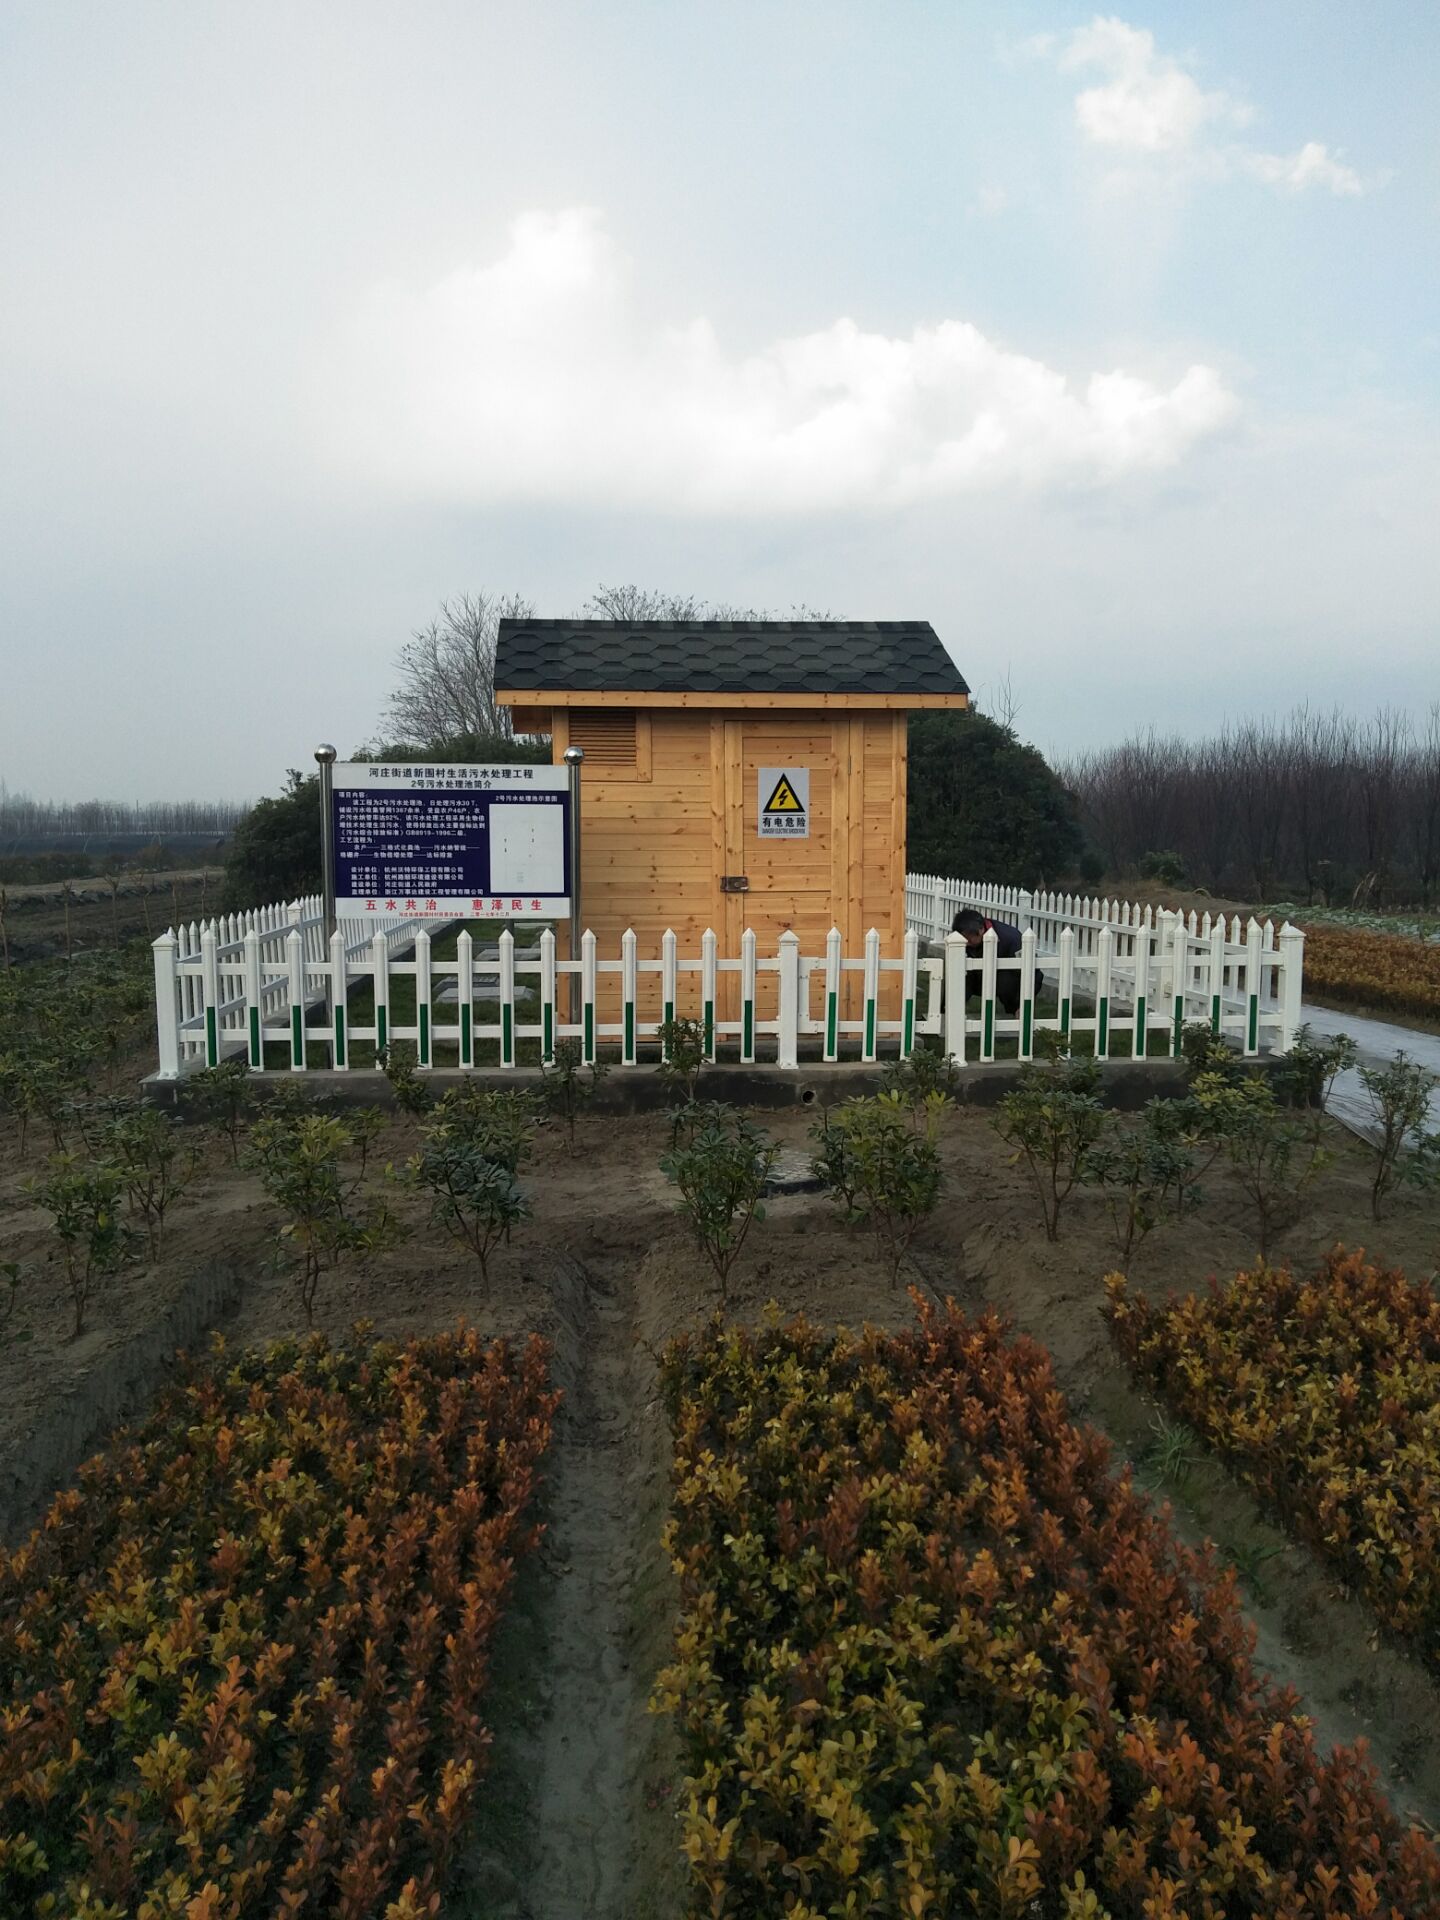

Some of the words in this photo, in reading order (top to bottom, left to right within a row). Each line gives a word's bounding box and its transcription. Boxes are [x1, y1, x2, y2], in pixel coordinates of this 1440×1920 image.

[369, 767, 534, 779] 河庄街道新围村生活污水处理工程
[410, 780, 492, 789] 2号污水处理池简介
[762, 817, 806, 827] 有电危险
[365, 899, 438, 911] 五水共治
[472, 899, 543, 911] 惠泽民生
